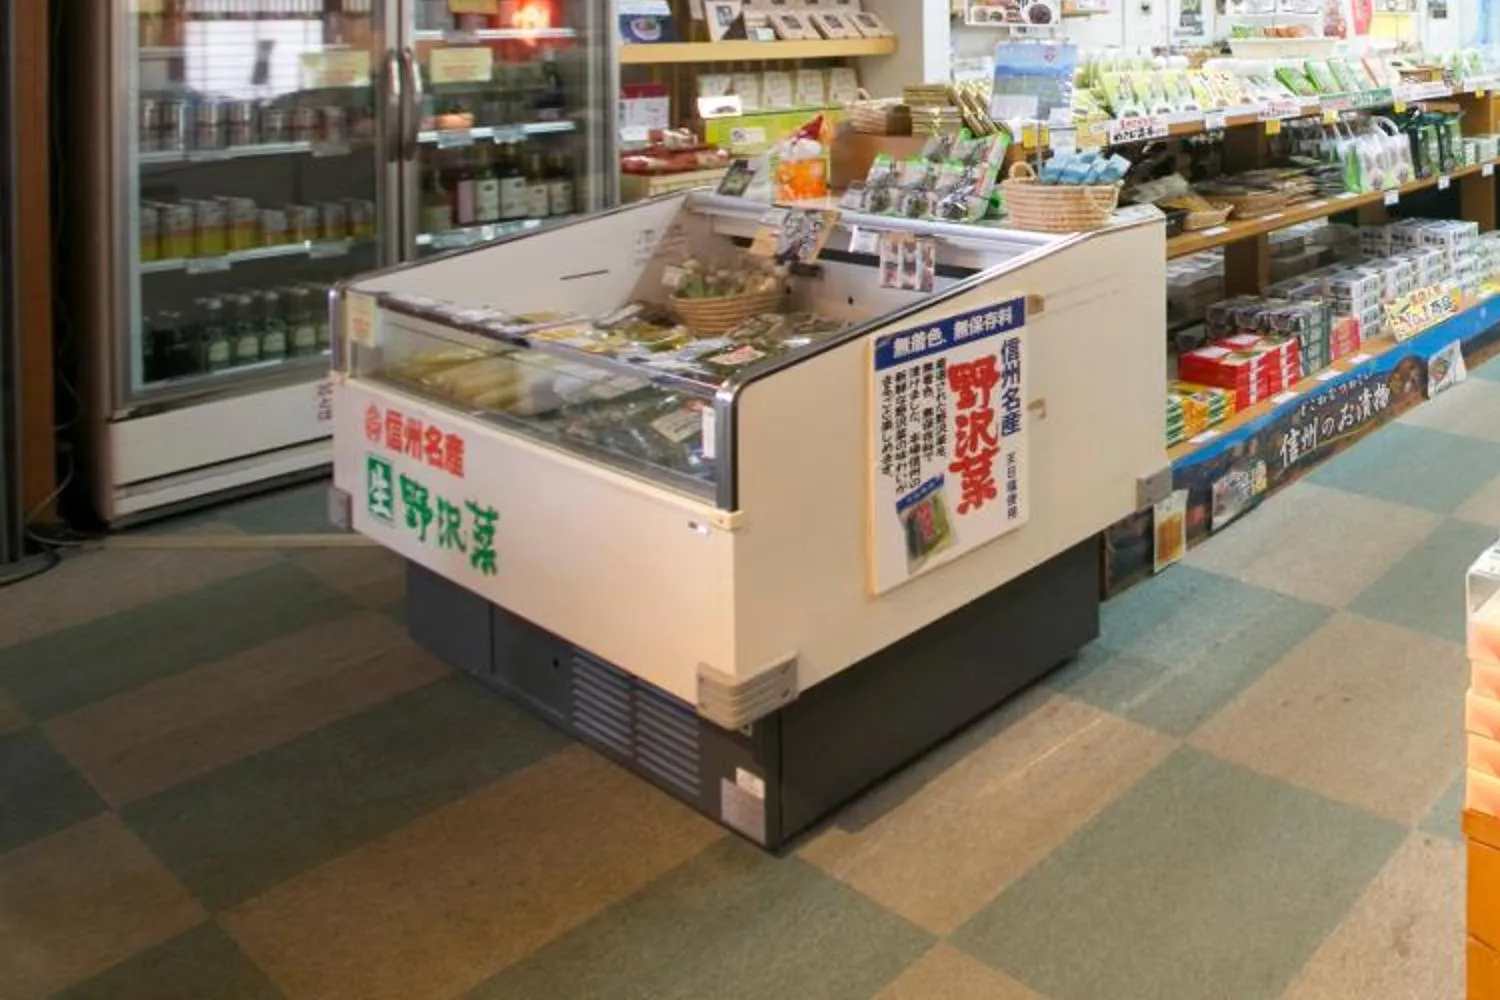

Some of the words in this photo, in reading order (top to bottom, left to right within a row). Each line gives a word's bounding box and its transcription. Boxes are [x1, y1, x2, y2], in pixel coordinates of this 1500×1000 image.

[1001, 336, 1021, 437] 信州名産
[1279, 382, 1391, 468] 信州のお漬物
[384, 408, 465, 479] 信州名産
[948, 354, 1001, 515] 野沢菜
